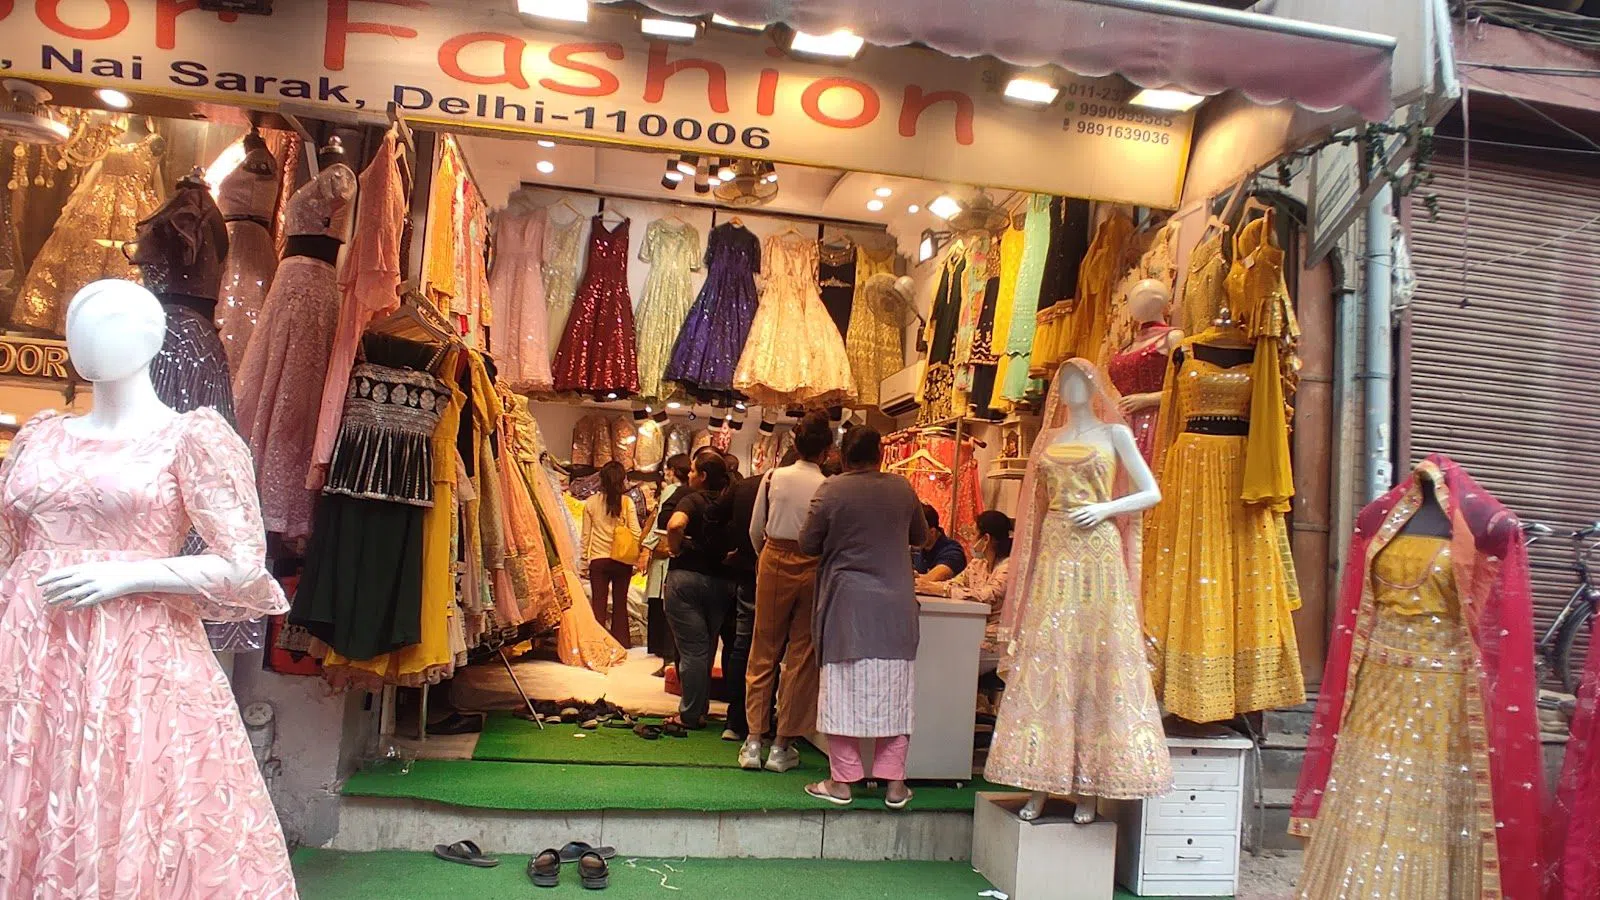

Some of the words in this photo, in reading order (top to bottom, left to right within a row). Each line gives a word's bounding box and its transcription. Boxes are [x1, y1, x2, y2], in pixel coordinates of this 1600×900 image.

[0, 0, 238, 50] or
[323, 0, 975, 146] Fashion
[41, 45, 143, 80] Nai
[168, 60, 367, 110] Sarak,
[391, 84, 771, 150] Delhi-110006
[1076, 120, 1171, 145] 9891639036
